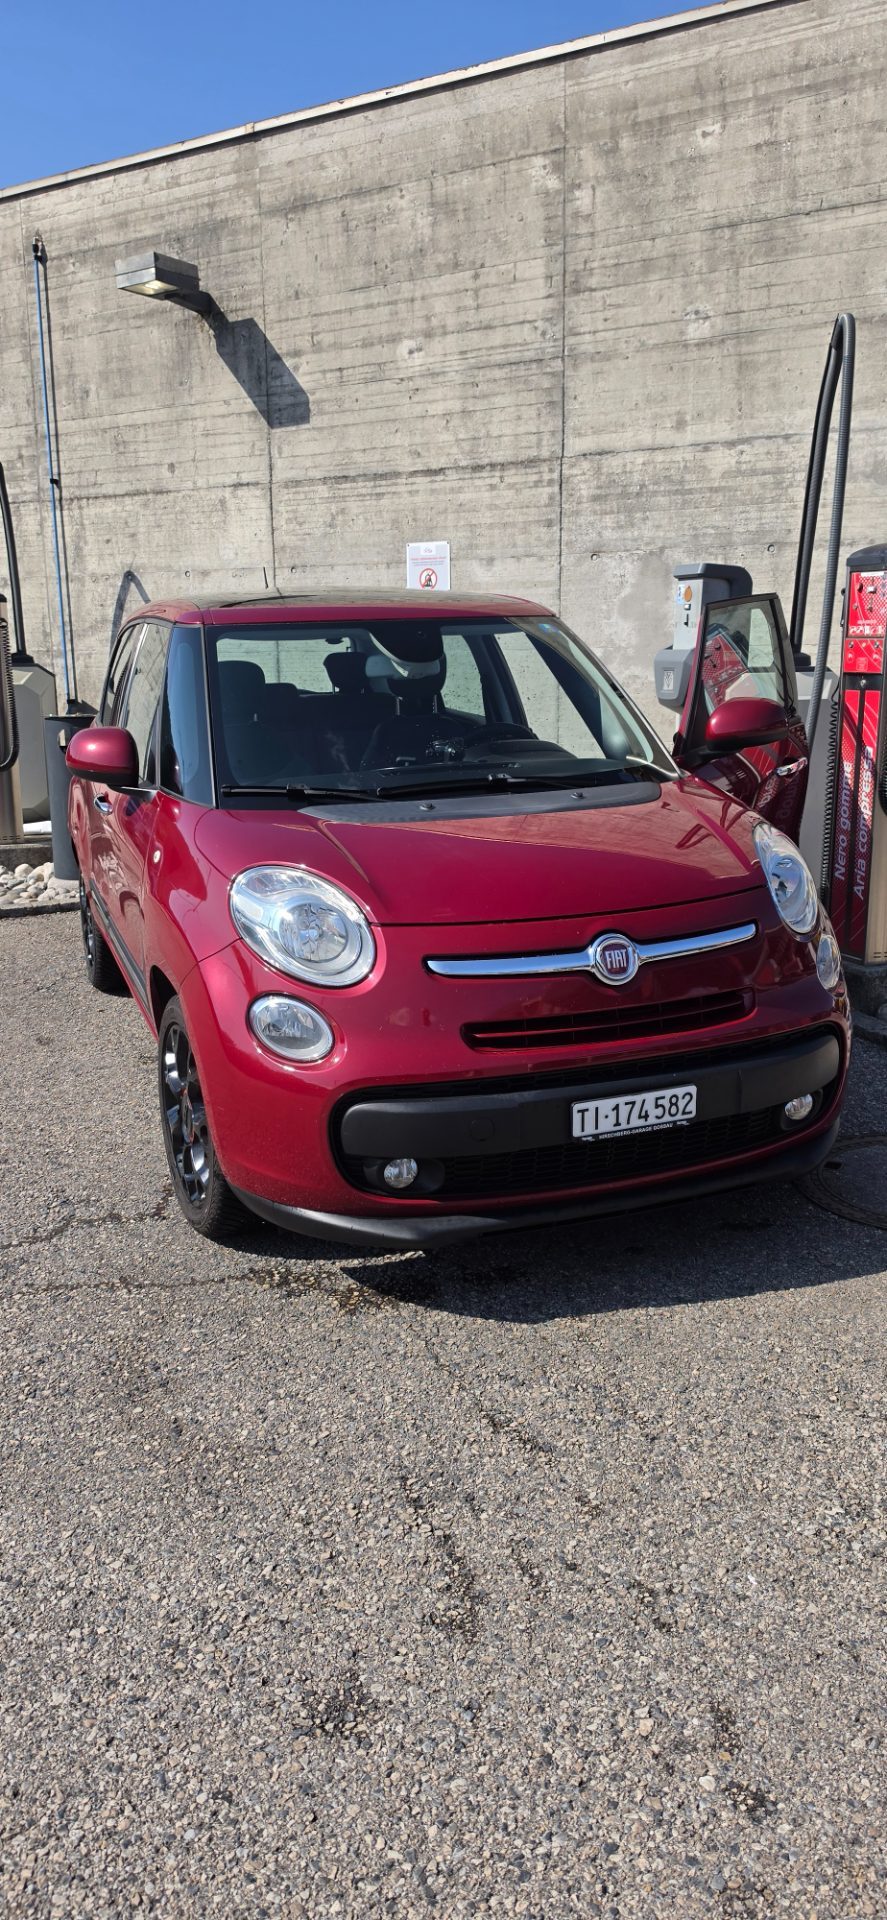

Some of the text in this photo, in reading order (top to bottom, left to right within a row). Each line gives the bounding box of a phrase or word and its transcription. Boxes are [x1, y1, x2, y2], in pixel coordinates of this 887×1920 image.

[834, 762, 853, 880] Nero gomme
[853, 745, 875, 900] Aria compressa
[605, 948, 627, 970] FIAT
